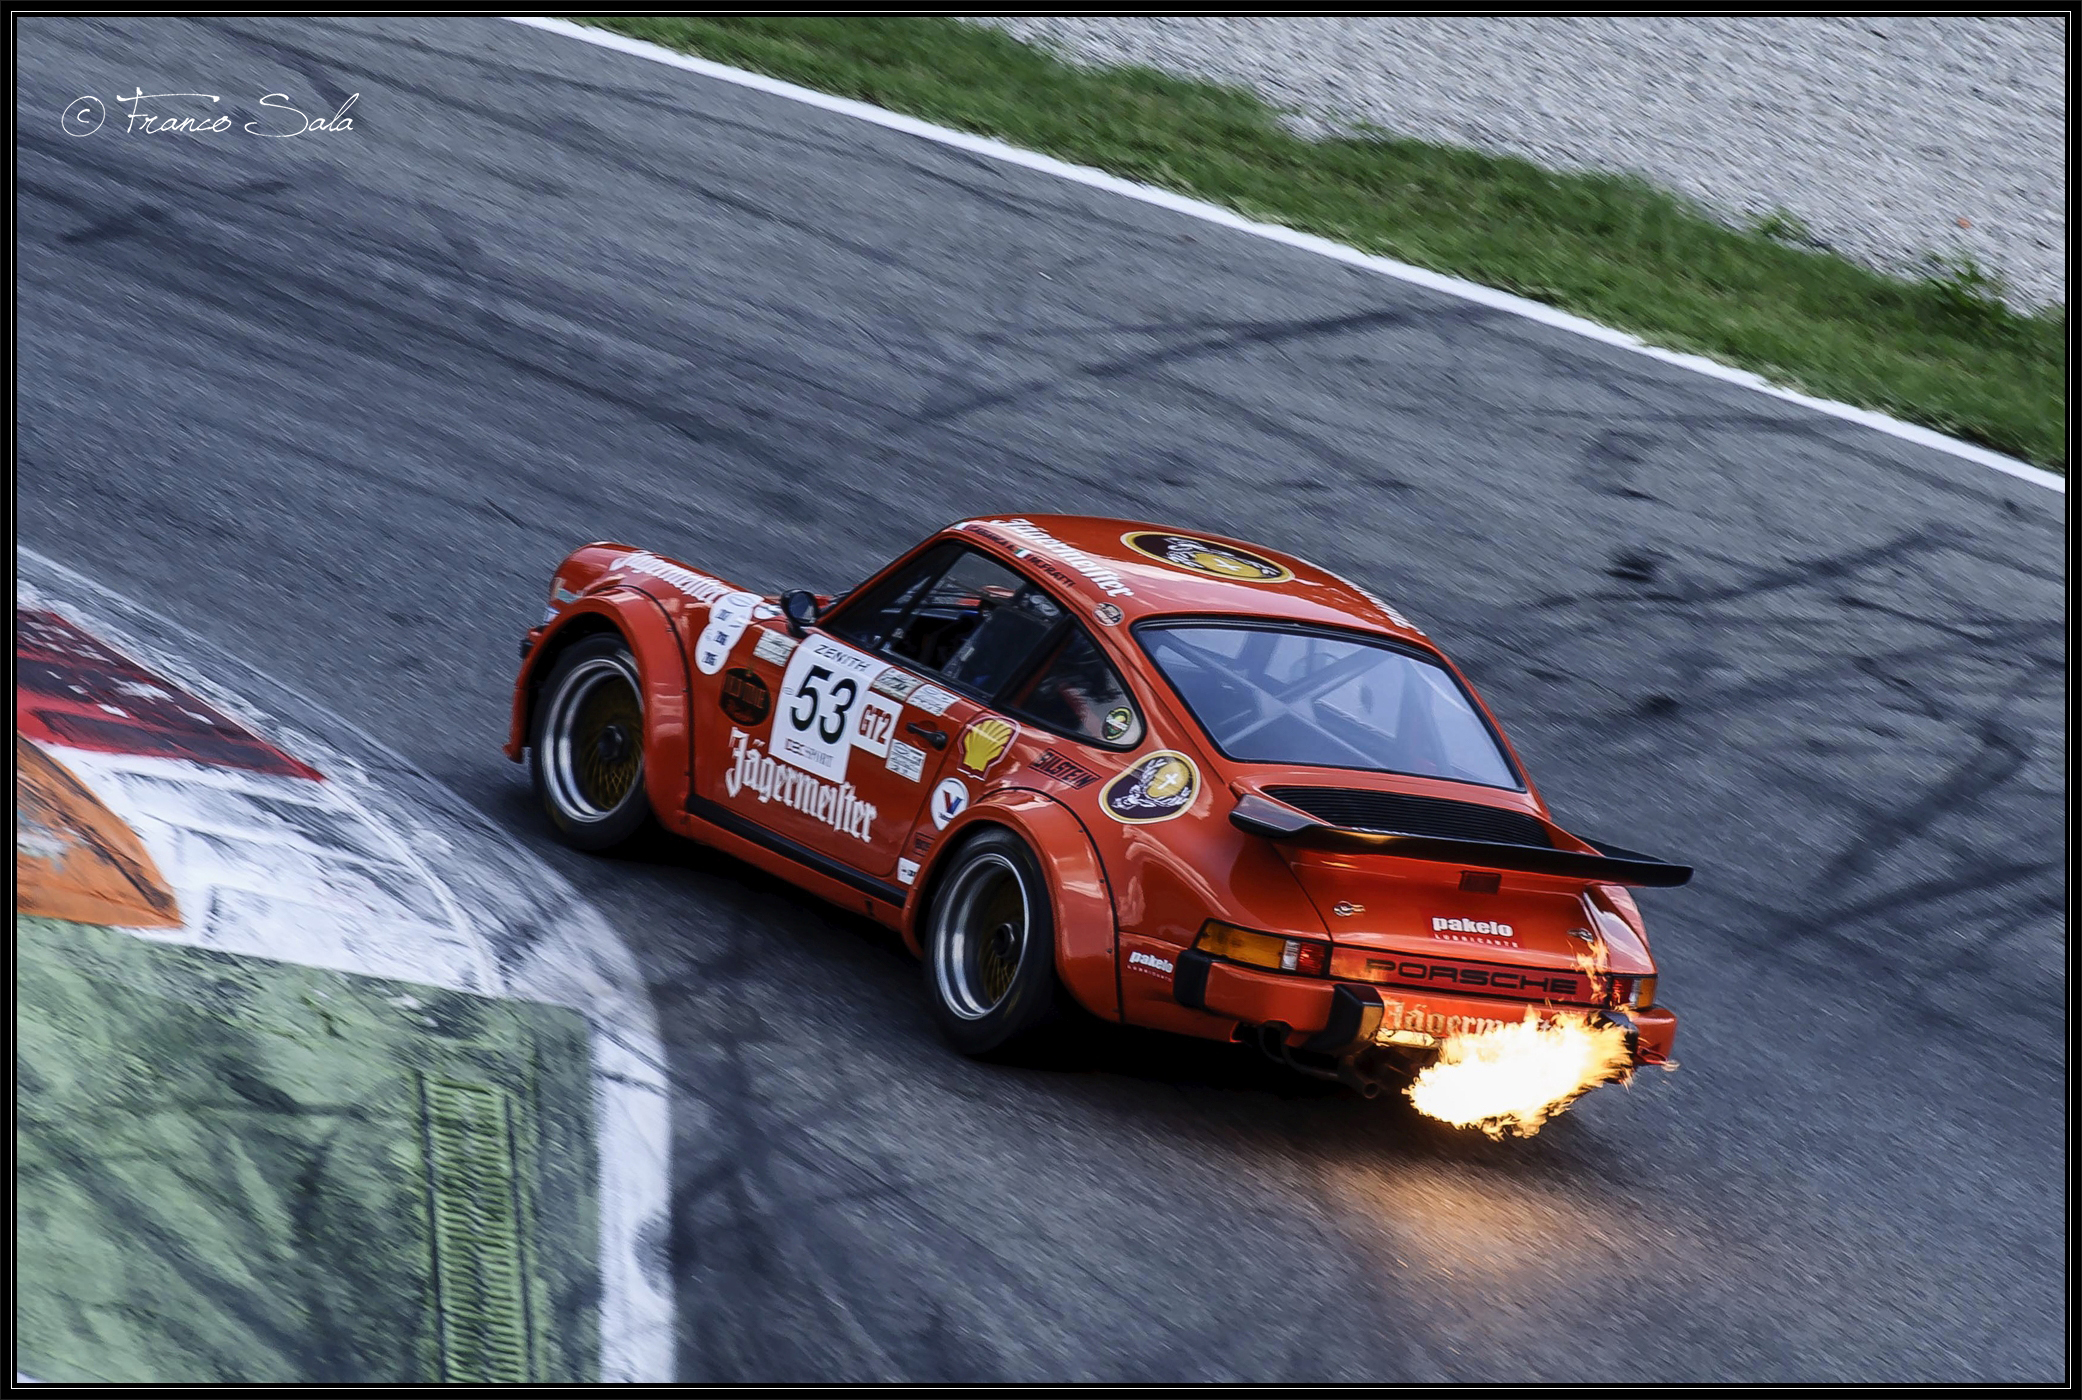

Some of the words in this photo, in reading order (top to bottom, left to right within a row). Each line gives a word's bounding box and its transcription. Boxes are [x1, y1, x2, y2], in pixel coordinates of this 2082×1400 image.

[814, 644, 871, 672] ZENITH
[789, 664, 858, 744] 53
[859, 704, 892, 745] GT2
[1033, 751, 1096, 790] BILSTEIN
[1432, 916, 1514, 938] pakelo
[1128, 951, 1174, 974] pakelo
[1366, 958, 1578, 996] PORSCHE
